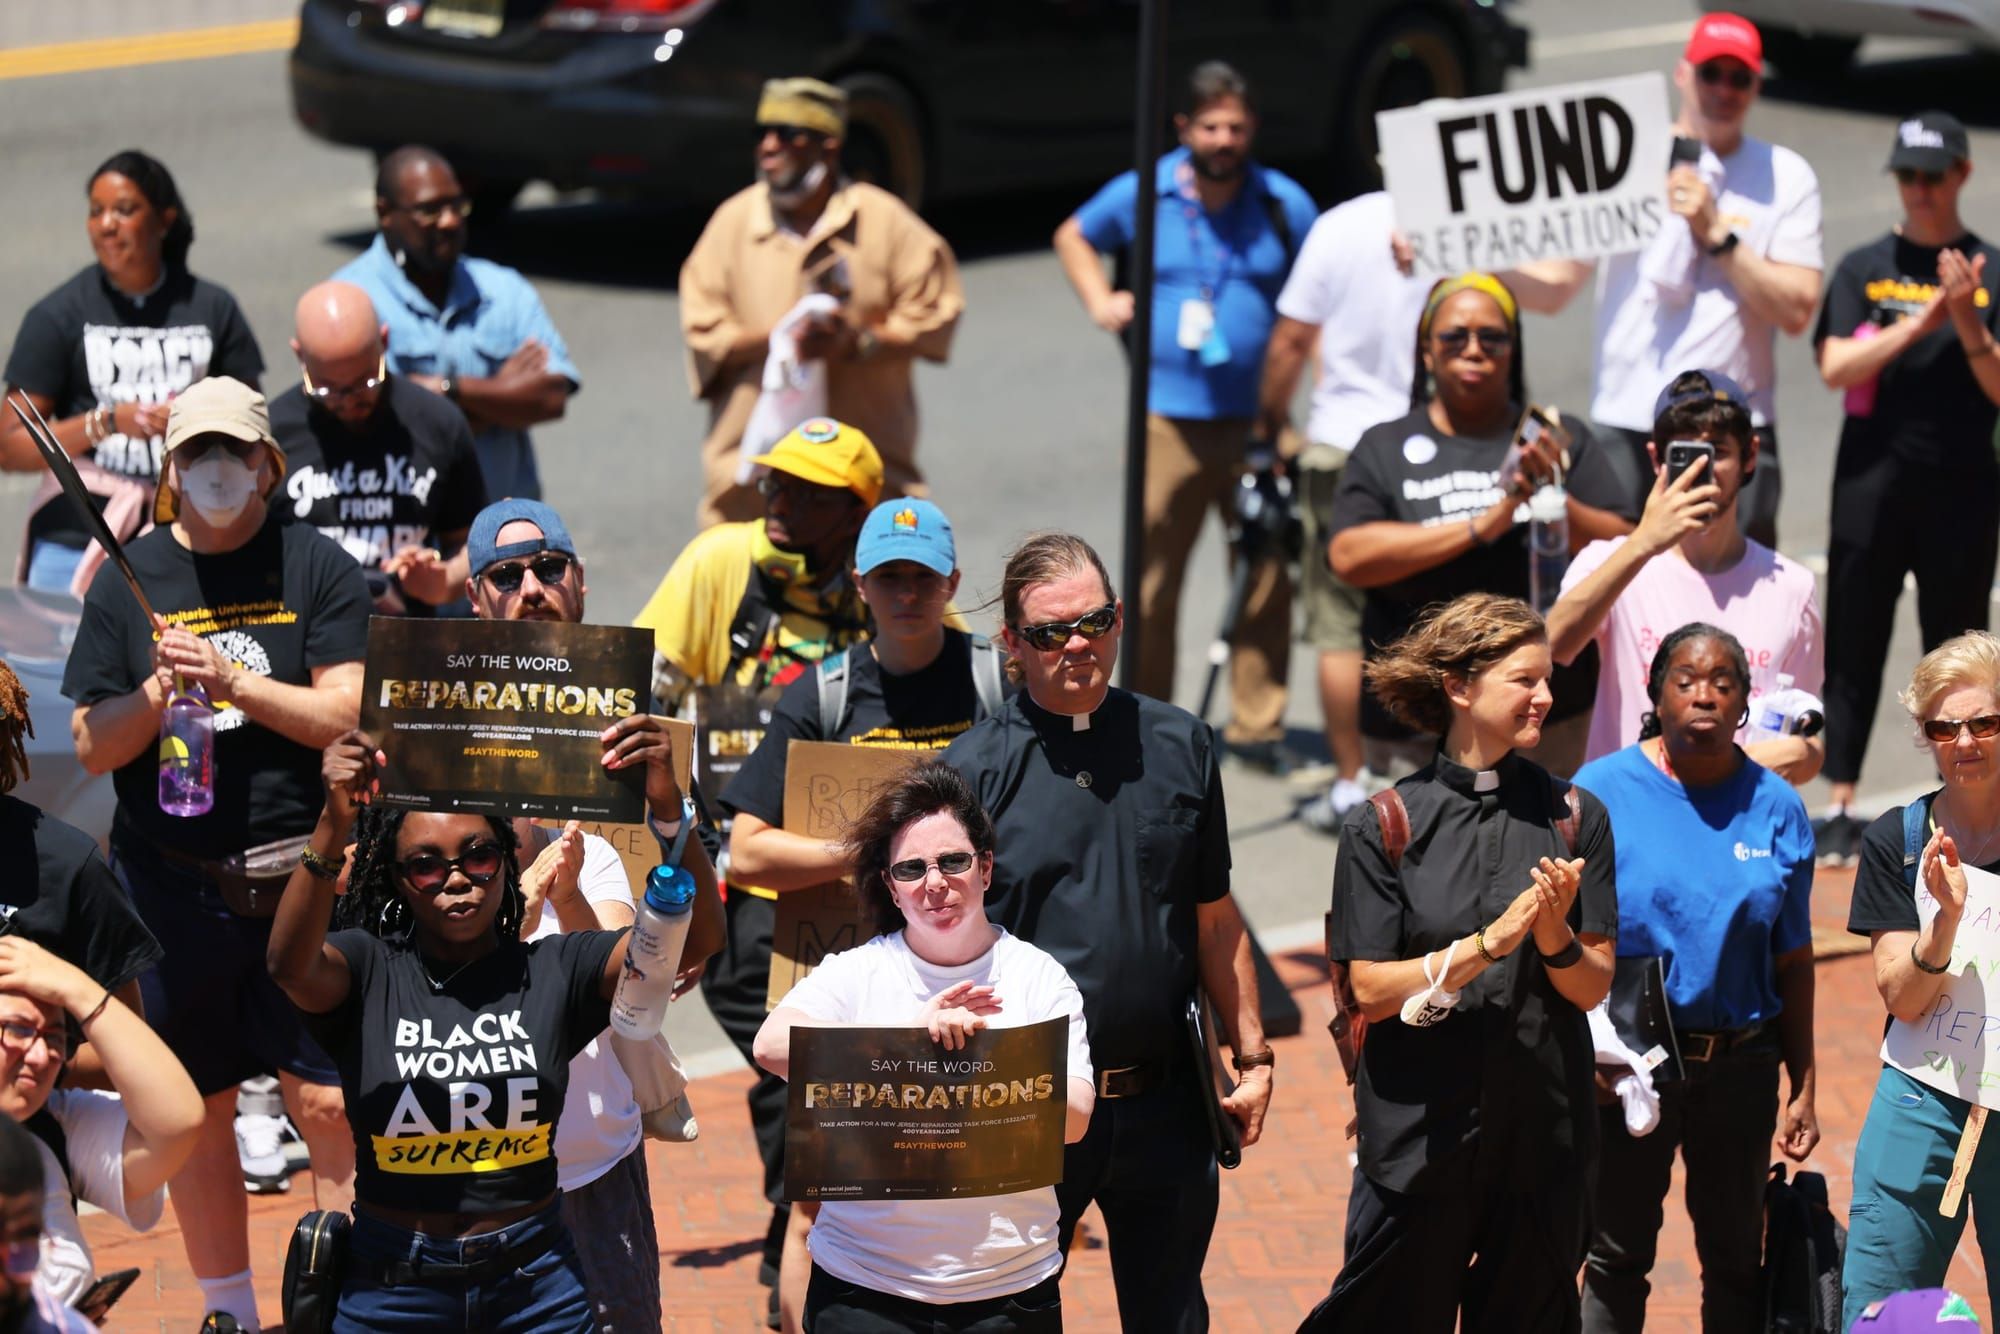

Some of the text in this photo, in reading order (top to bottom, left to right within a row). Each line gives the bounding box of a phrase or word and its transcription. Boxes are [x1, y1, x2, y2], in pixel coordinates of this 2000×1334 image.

[1437, 96, 1634, 214] FUND
[1407, 196, 1663, 275] REPARATIONS
[287, 453, 437, 518] Just a Kid
[339, 497, 392, 520] FROM
[447, 655, 573, 673] SAY THE WORD.
[379, 679, 636, 718] REPARATIONS
[393, 722, 409, 730] TAKE
[409, 723, 433, 731] ACTION
[433, 723, 446, 731] FOR
[446, 723, 452, 731] A
[467, 724, 490, 732] JERSEY
[490, 725, 535, 734] REPARATIONS
[536, 727, 553, 735] TASK
[554, 727, 577, 737] FORCE
[463, 747, 539, 759] #SAYTHEWORD
[395, 1010, 529, 1049] BLACK
[1926, 993, 2000, 1050] REP
[395, 1044, 538, 1079] WOMEN
[871, 1060, 997, 1073] SAY THE WORD.
[383, 1077, 539, 1138] ARE
[805, 1073, 1053, 1110] REPARATIONS
[836, 1120, 860, 1128] ACTION
[964, 1120, 979, 1128] TASK
[980, 1118, 1001, 1127] FORCE
[388, 1134, 539, 1167] SUPREME
[893, 1140, 967, 1150] #SAYTHEWORD
